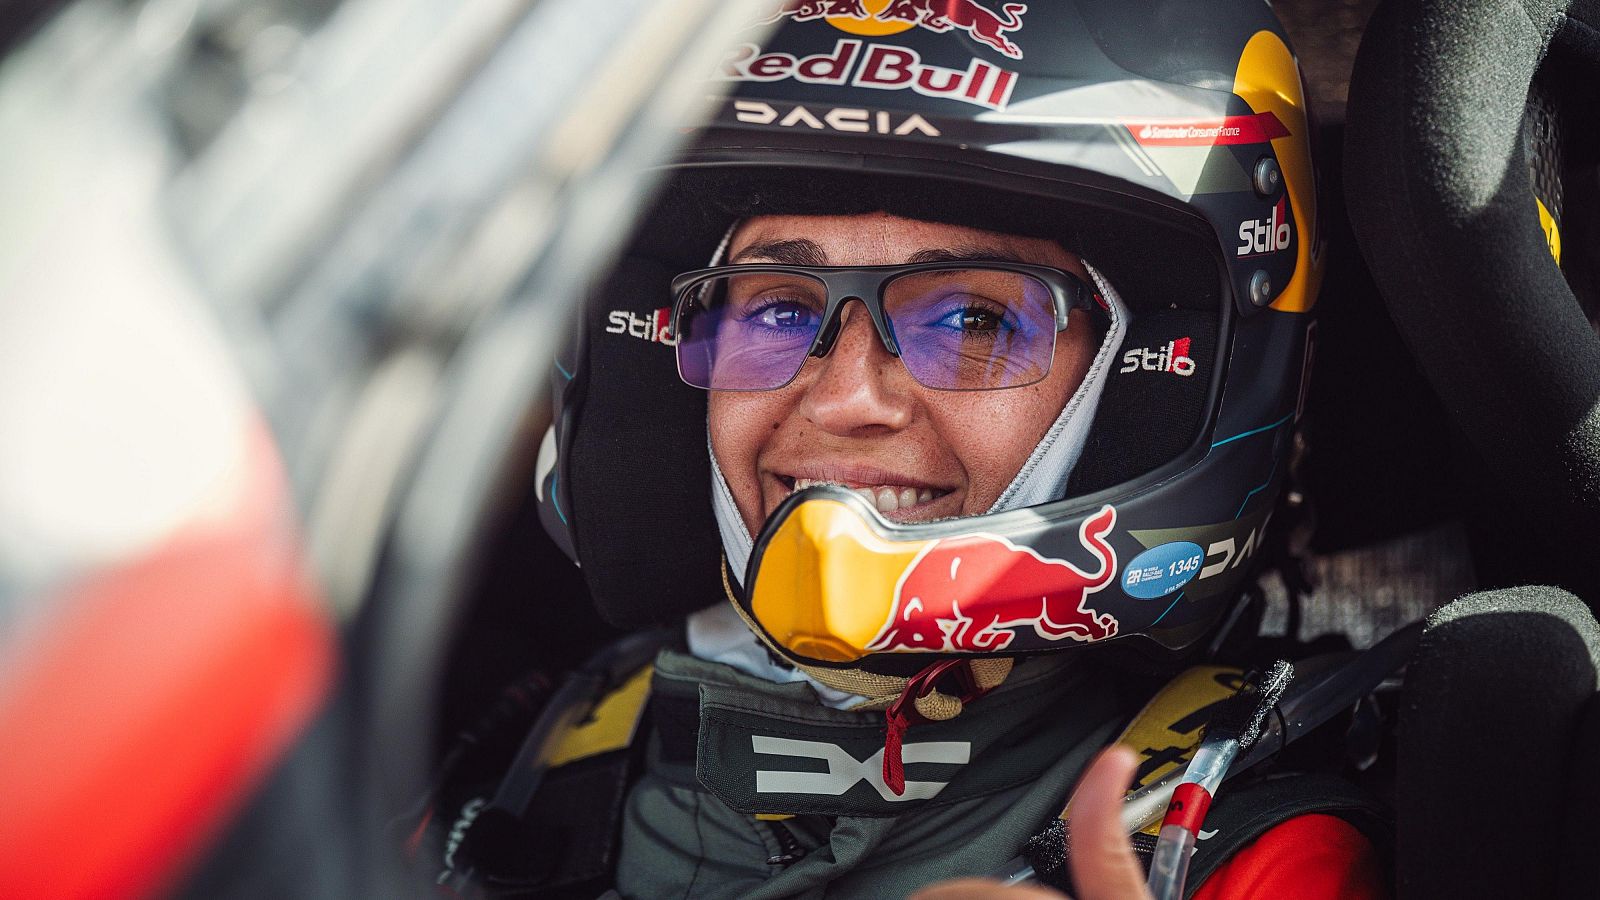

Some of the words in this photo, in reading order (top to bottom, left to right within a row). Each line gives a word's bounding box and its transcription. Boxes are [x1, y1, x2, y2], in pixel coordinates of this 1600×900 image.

[851, 43, 1019, 113] Bull
[733, 100, 941, 137] DACIA
[1237, 200, 1291, 256] Stilo
[1120, 337, 1196, 376] Stilo
[1169, 554, 1200, 577] 1345
